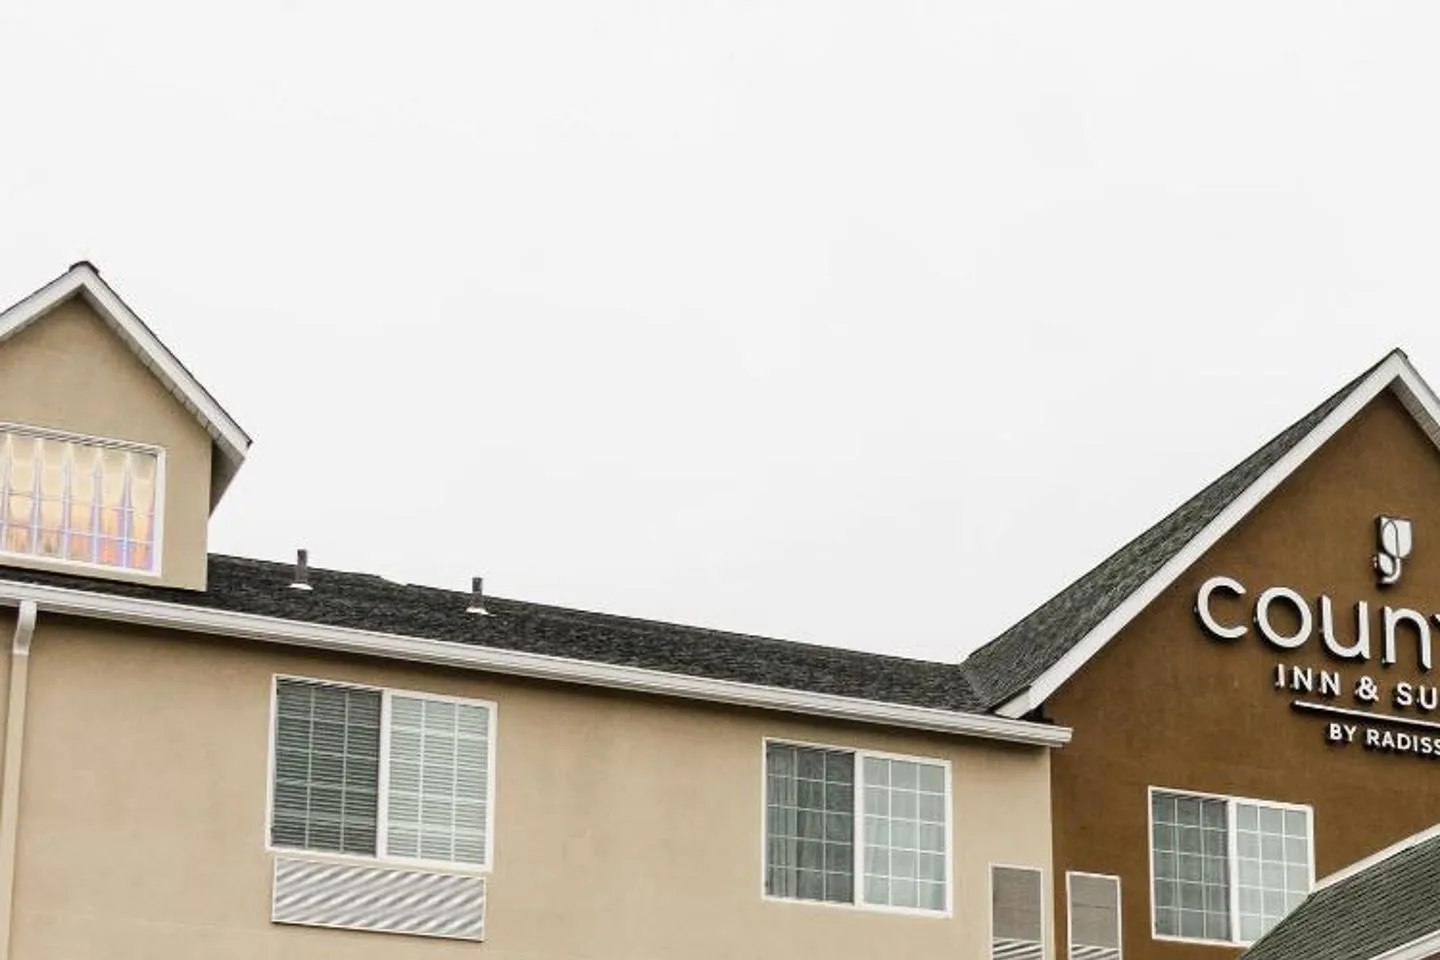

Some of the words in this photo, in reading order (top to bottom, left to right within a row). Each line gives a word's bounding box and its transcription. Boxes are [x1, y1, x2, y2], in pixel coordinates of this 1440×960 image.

[1275, 663, 1341, 697] INN
[1355, 675, 1379, 702] &
[1329, 723, 1357, 743] BY
